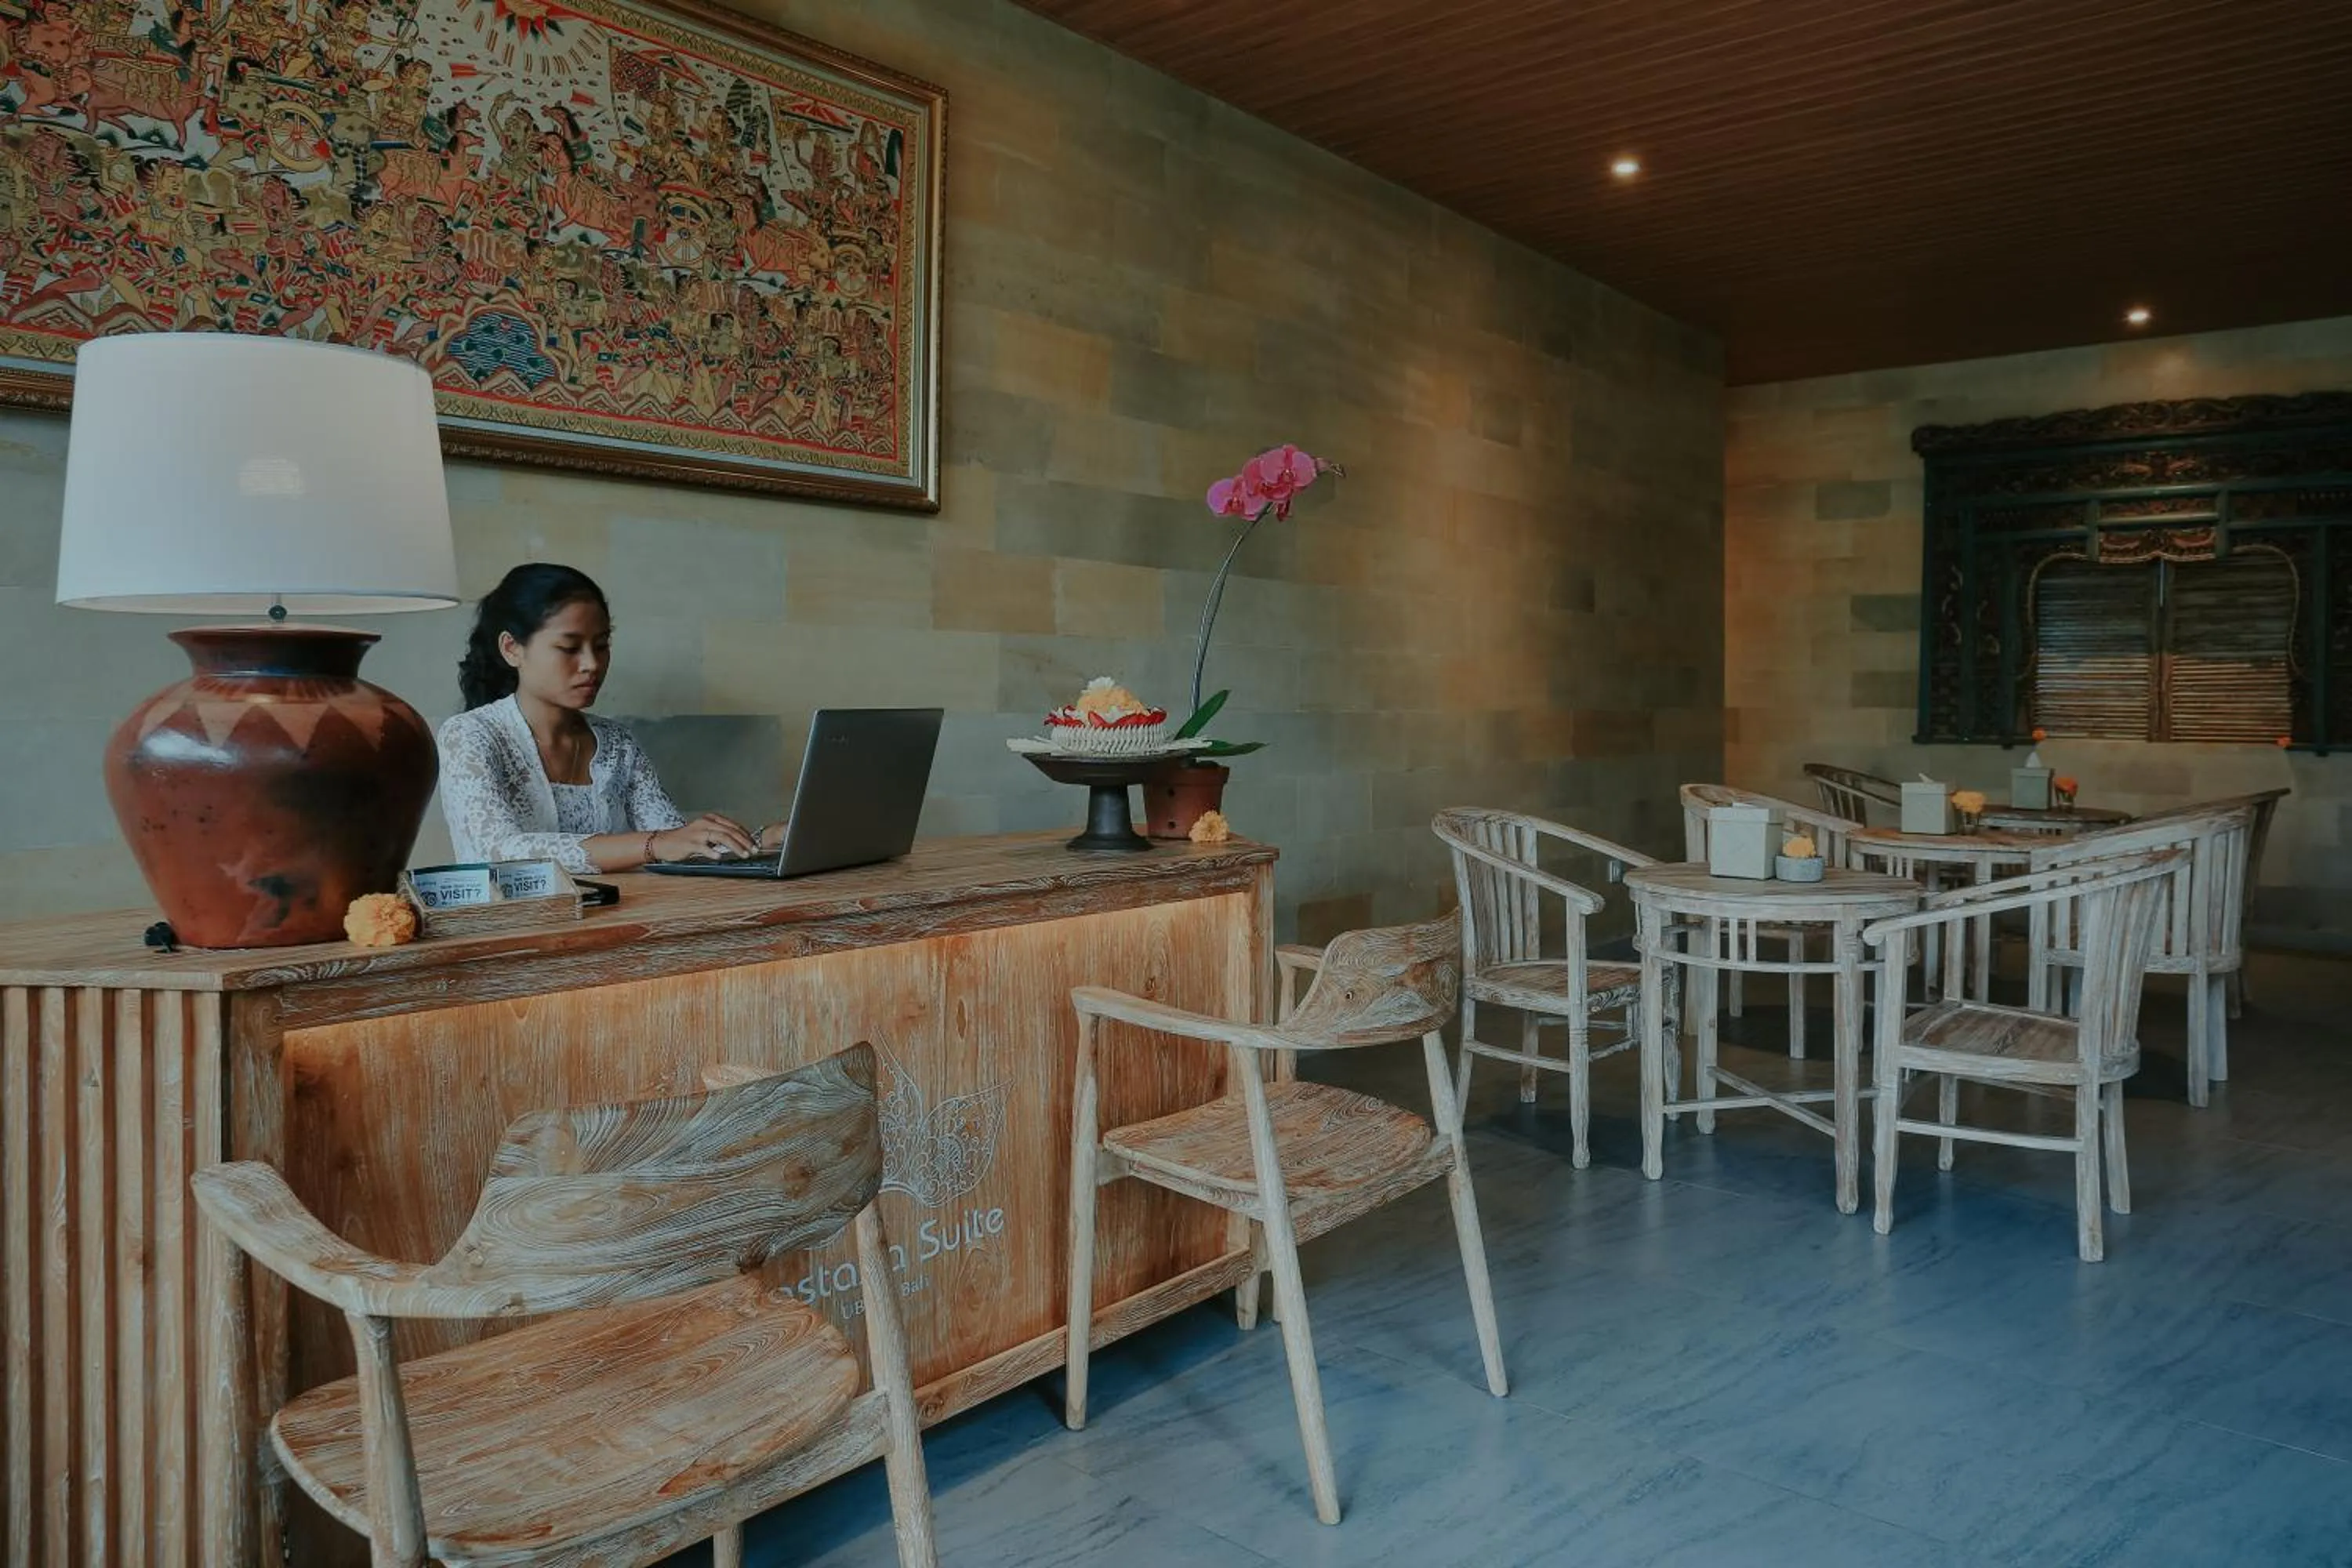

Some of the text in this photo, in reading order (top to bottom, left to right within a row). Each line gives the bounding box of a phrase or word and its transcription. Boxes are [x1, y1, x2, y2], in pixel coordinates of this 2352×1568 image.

[514, 879, 547, 891] VISIT?
[440, 888, 482, 900] VISIT?
[778, 1207, 1004, 1305] staa Suite
